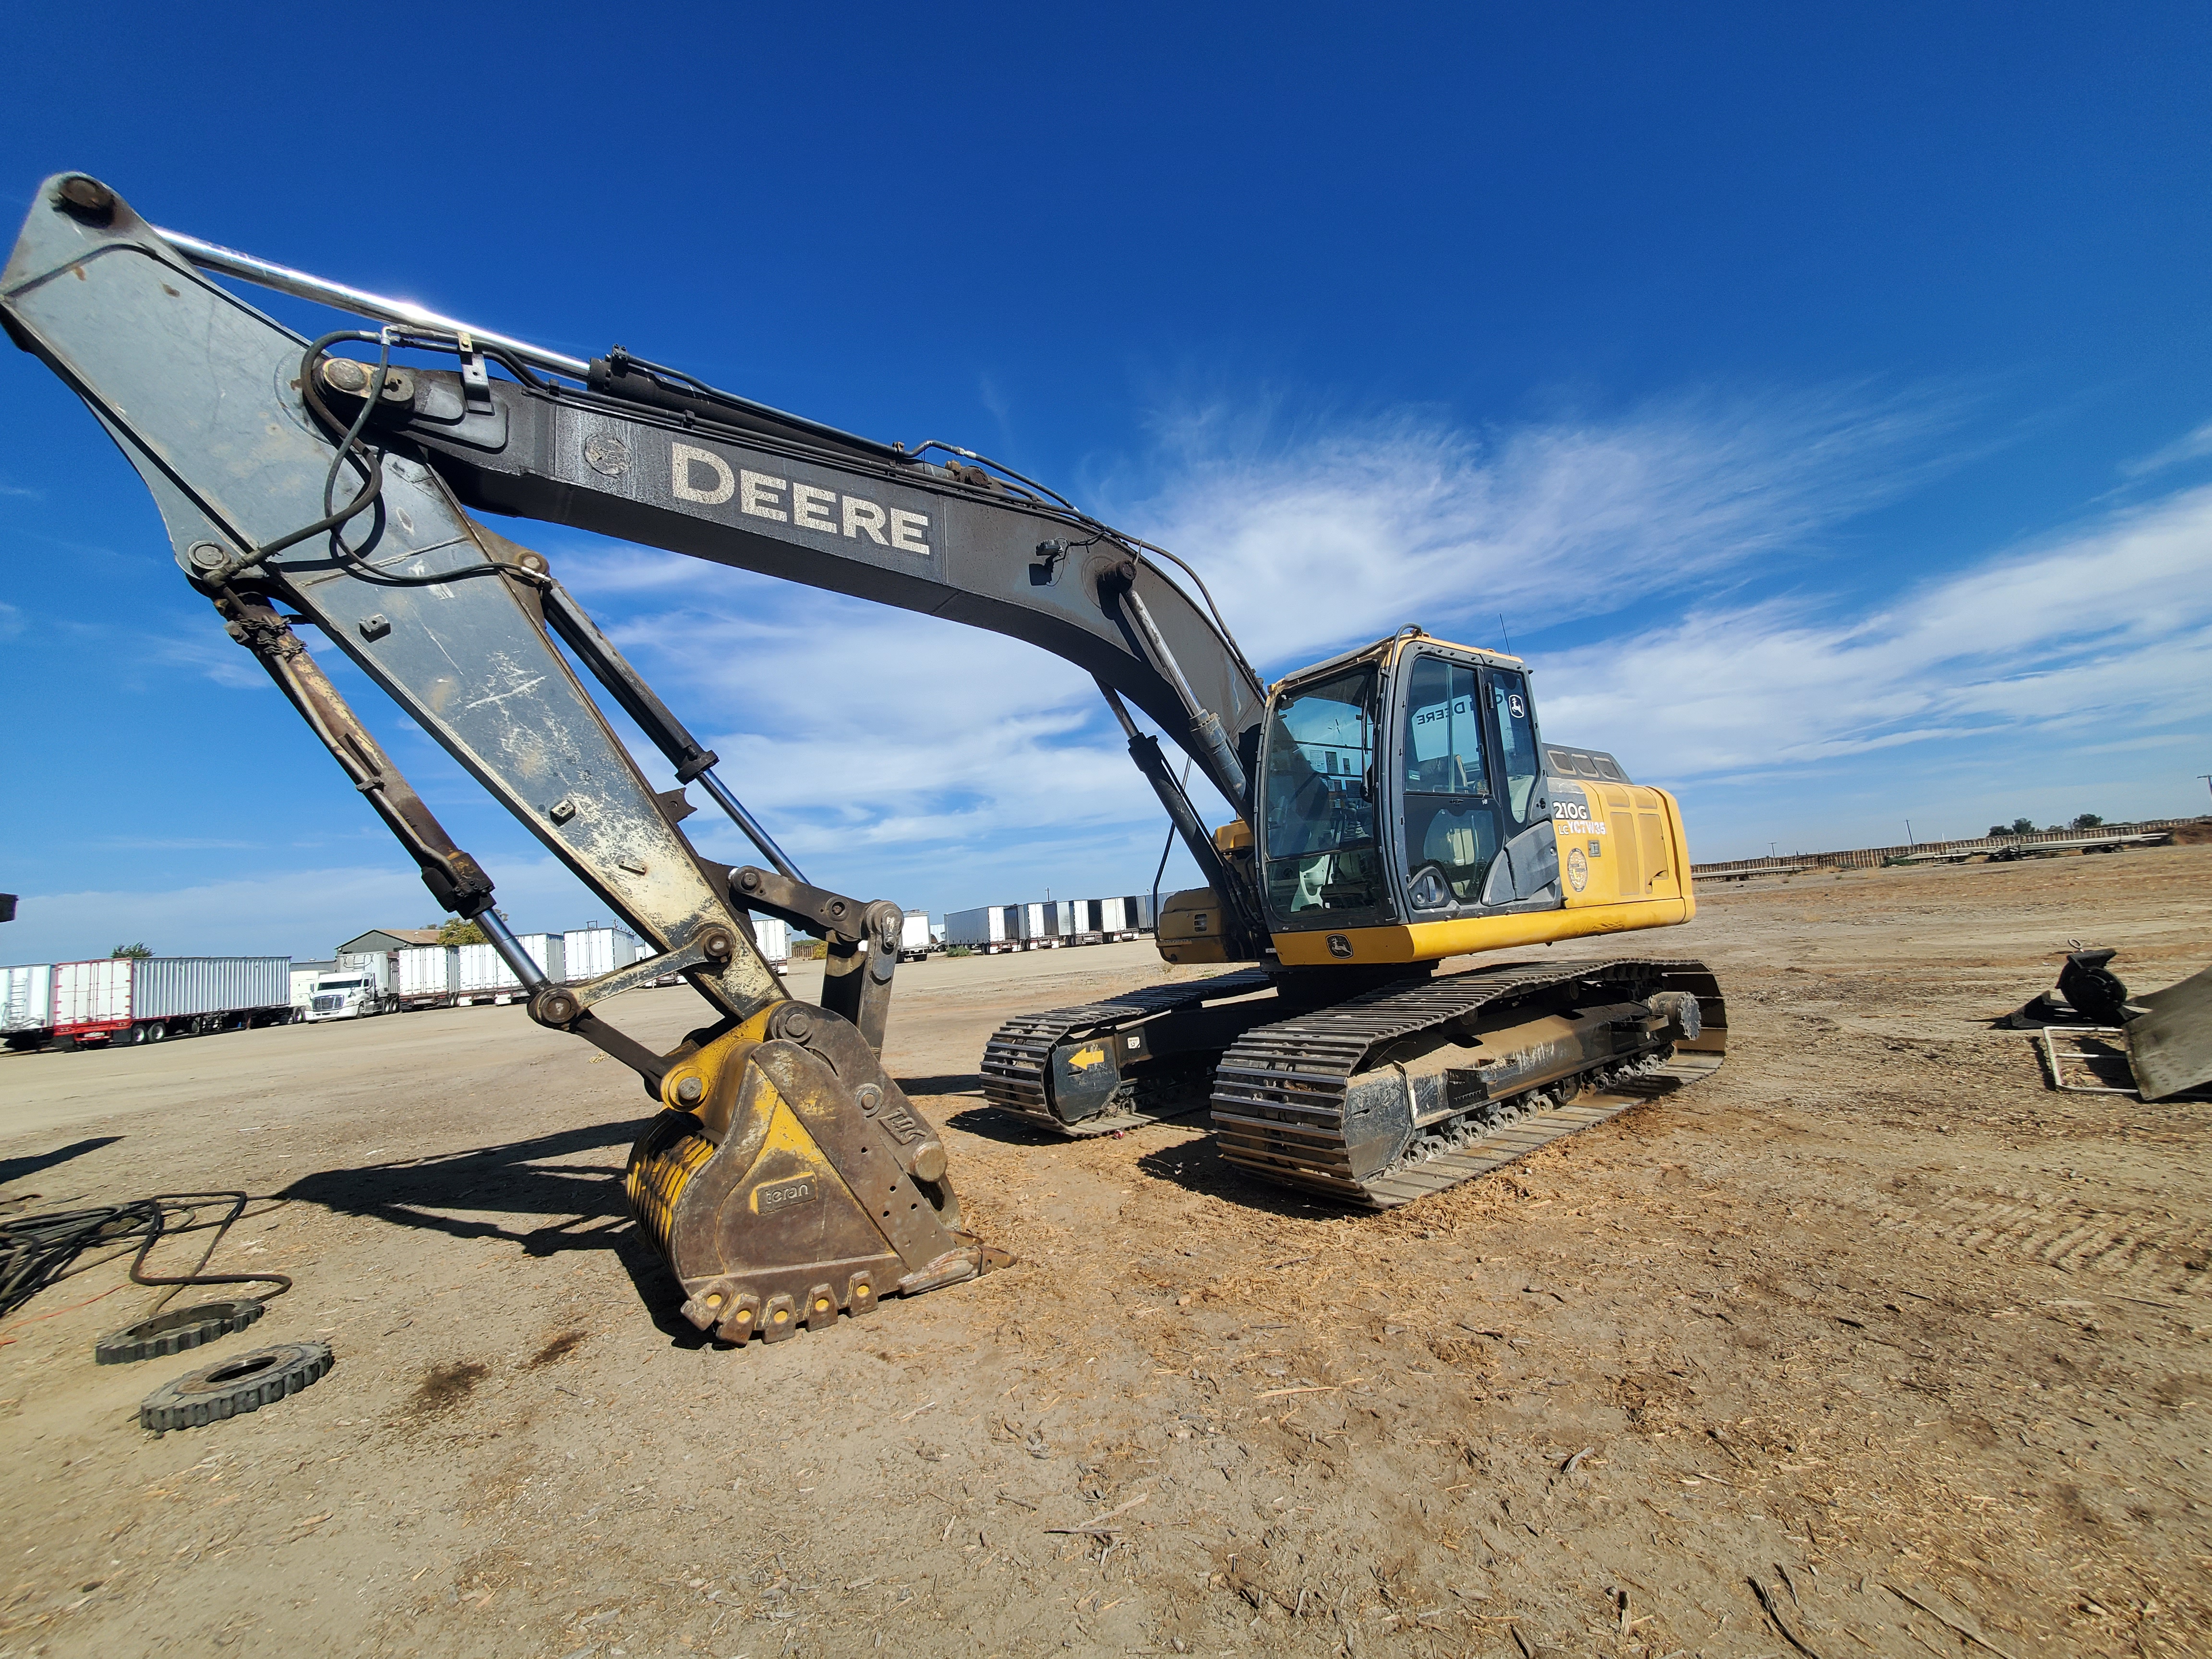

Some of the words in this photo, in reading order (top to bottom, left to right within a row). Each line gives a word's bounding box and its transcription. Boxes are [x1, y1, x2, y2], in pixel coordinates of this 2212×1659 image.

[672, 442, 930, 555] DEERE
[1552, 801, 1588, 819] 210G
[1558, 825, 1569, 835] LC
[765, 1184, 808, 1204] teran
